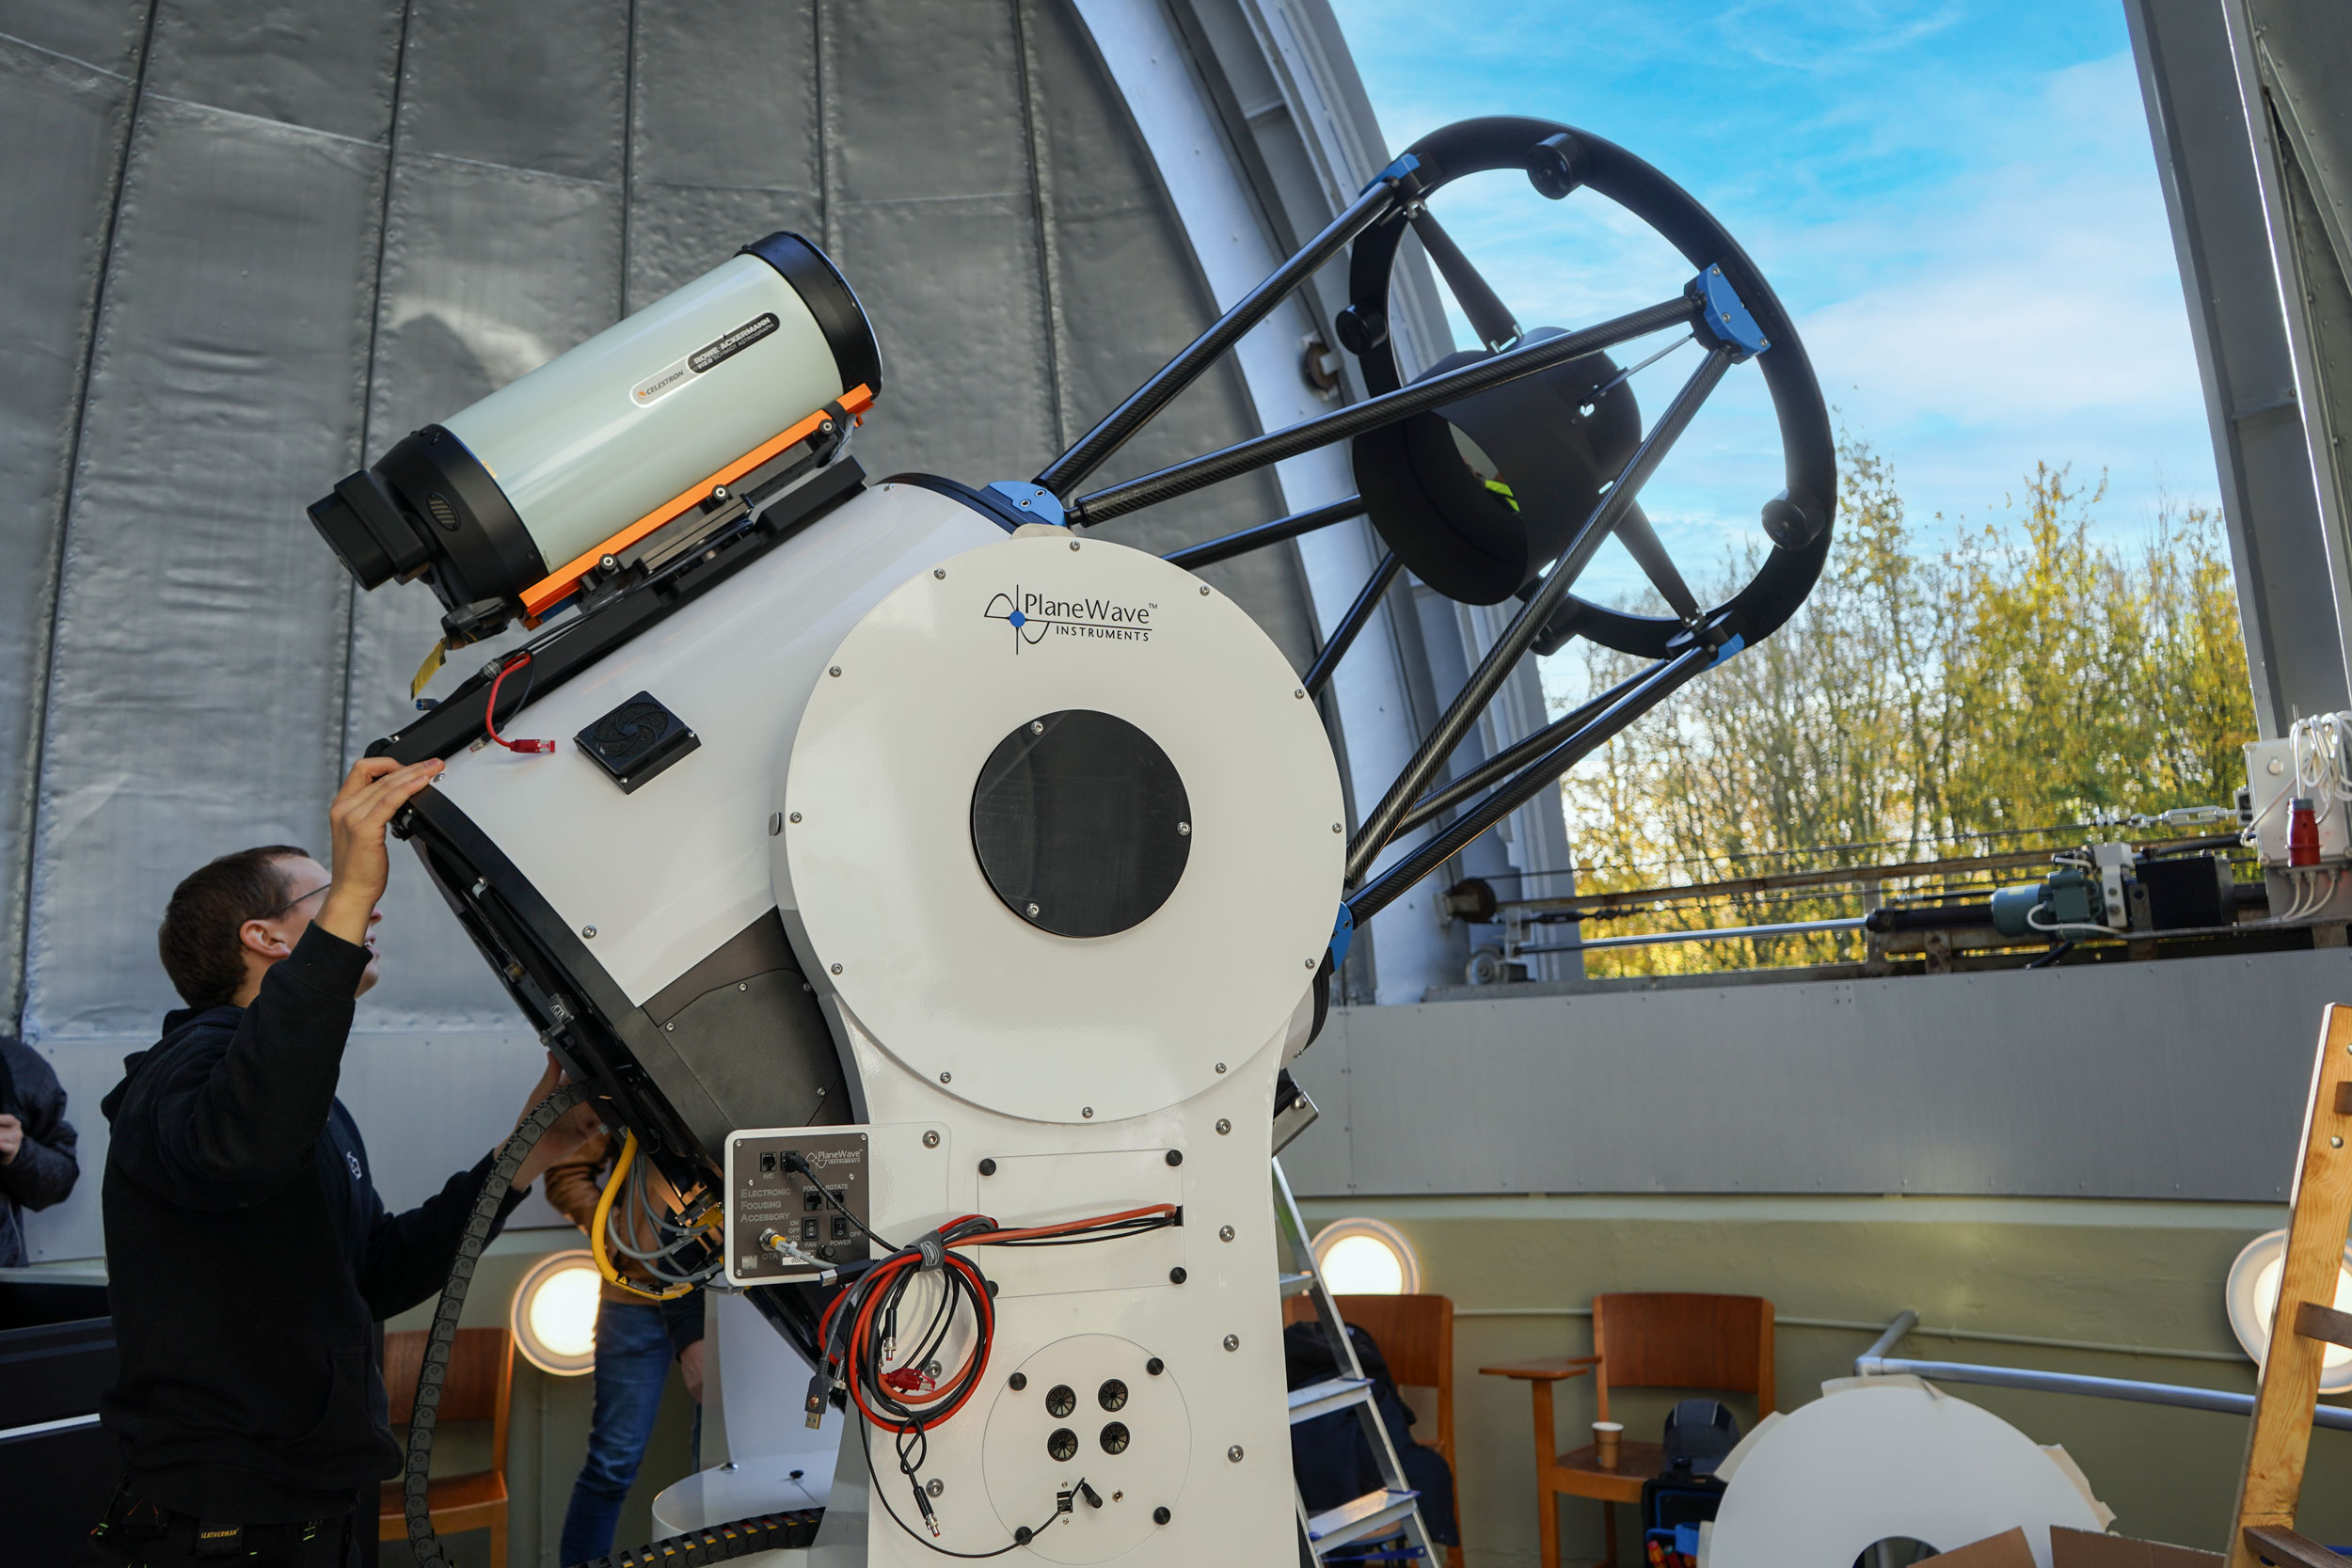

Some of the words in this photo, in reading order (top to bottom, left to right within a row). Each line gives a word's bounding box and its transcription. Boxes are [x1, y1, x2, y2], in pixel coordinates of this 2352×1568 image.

[693, 317, 771, 364] ROWE-ACKERMANN
[713, 343, 737, 360] SCHMIDT
[738, 323, 774, 346] ASTROGRAPH
[646, 370, 684, 395] CELESTRON
[1056, 626, 1149, 641] INSTRUMENTS
[200, 1528, 239, 1539] LEATHERMAN
